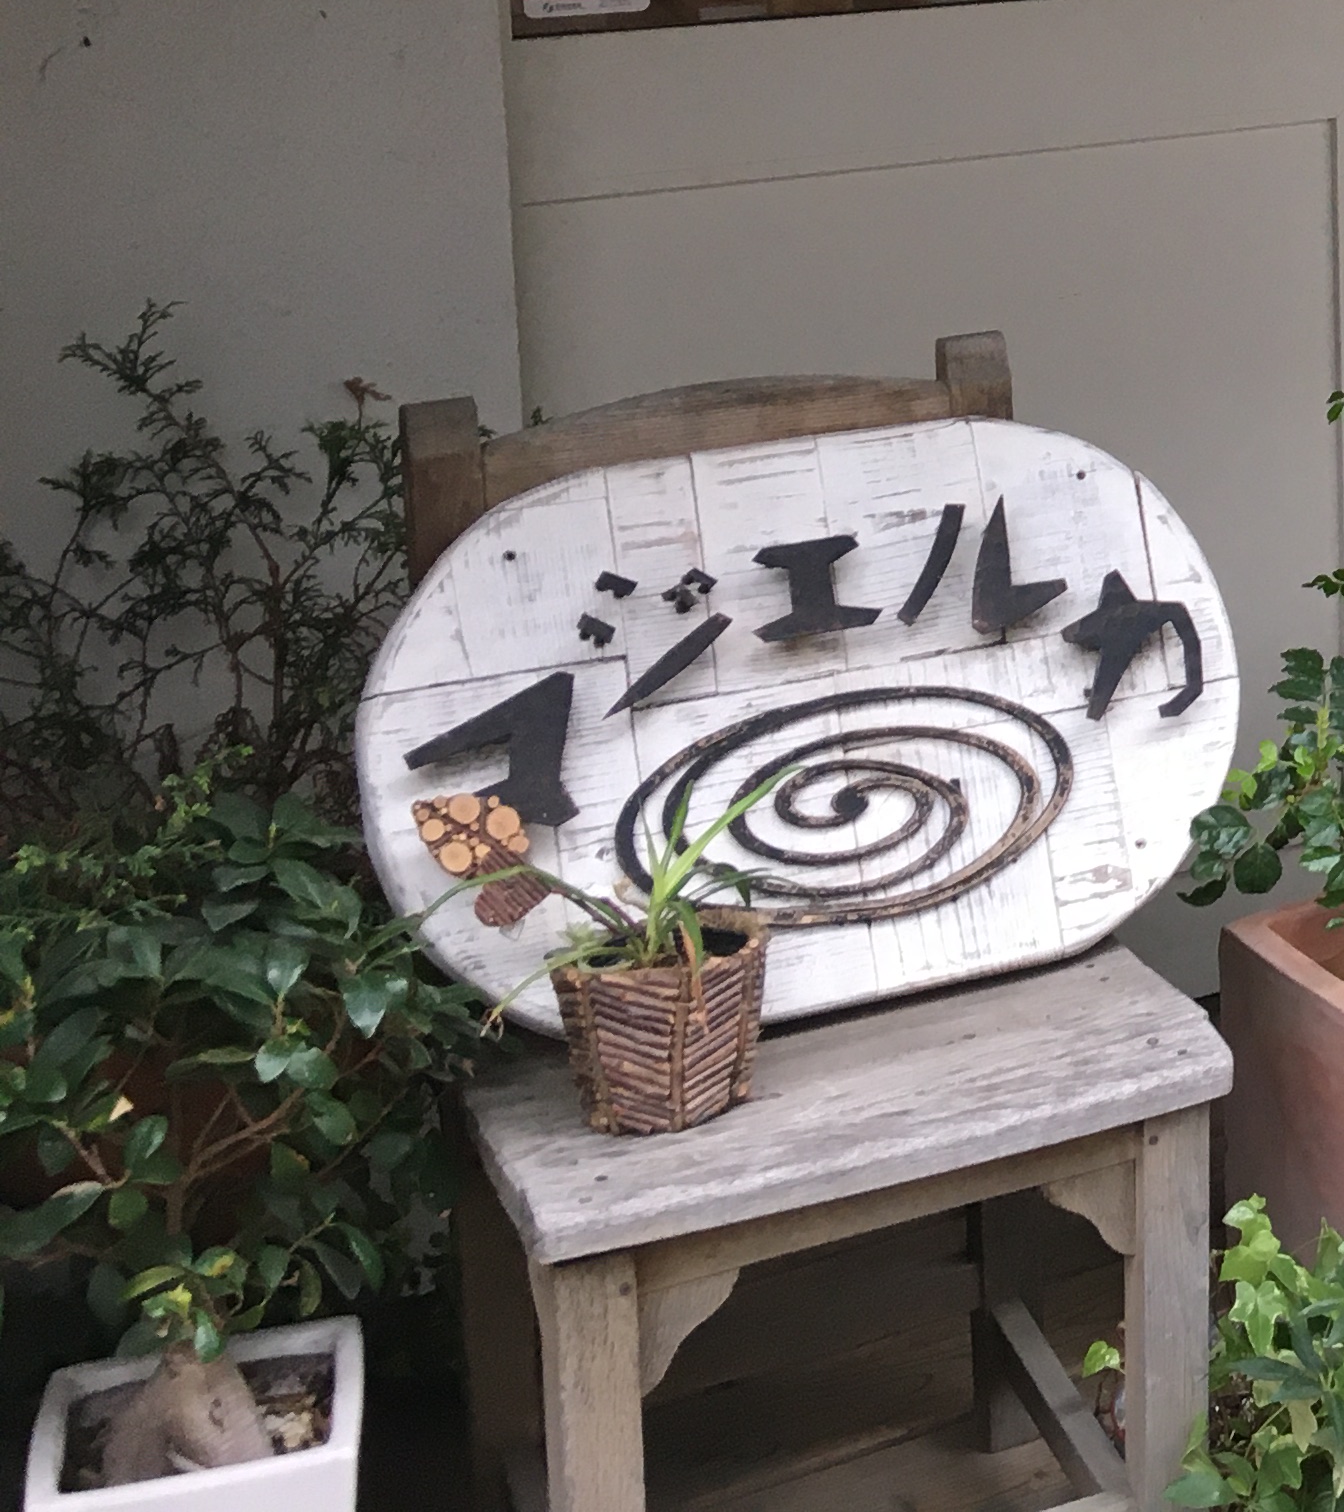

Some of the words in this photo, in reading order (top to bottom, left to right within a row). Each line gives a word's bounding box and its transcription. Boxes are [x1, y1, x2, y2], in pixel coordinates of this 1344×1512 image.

[403, 494, 1203, 828] マジェルカ
